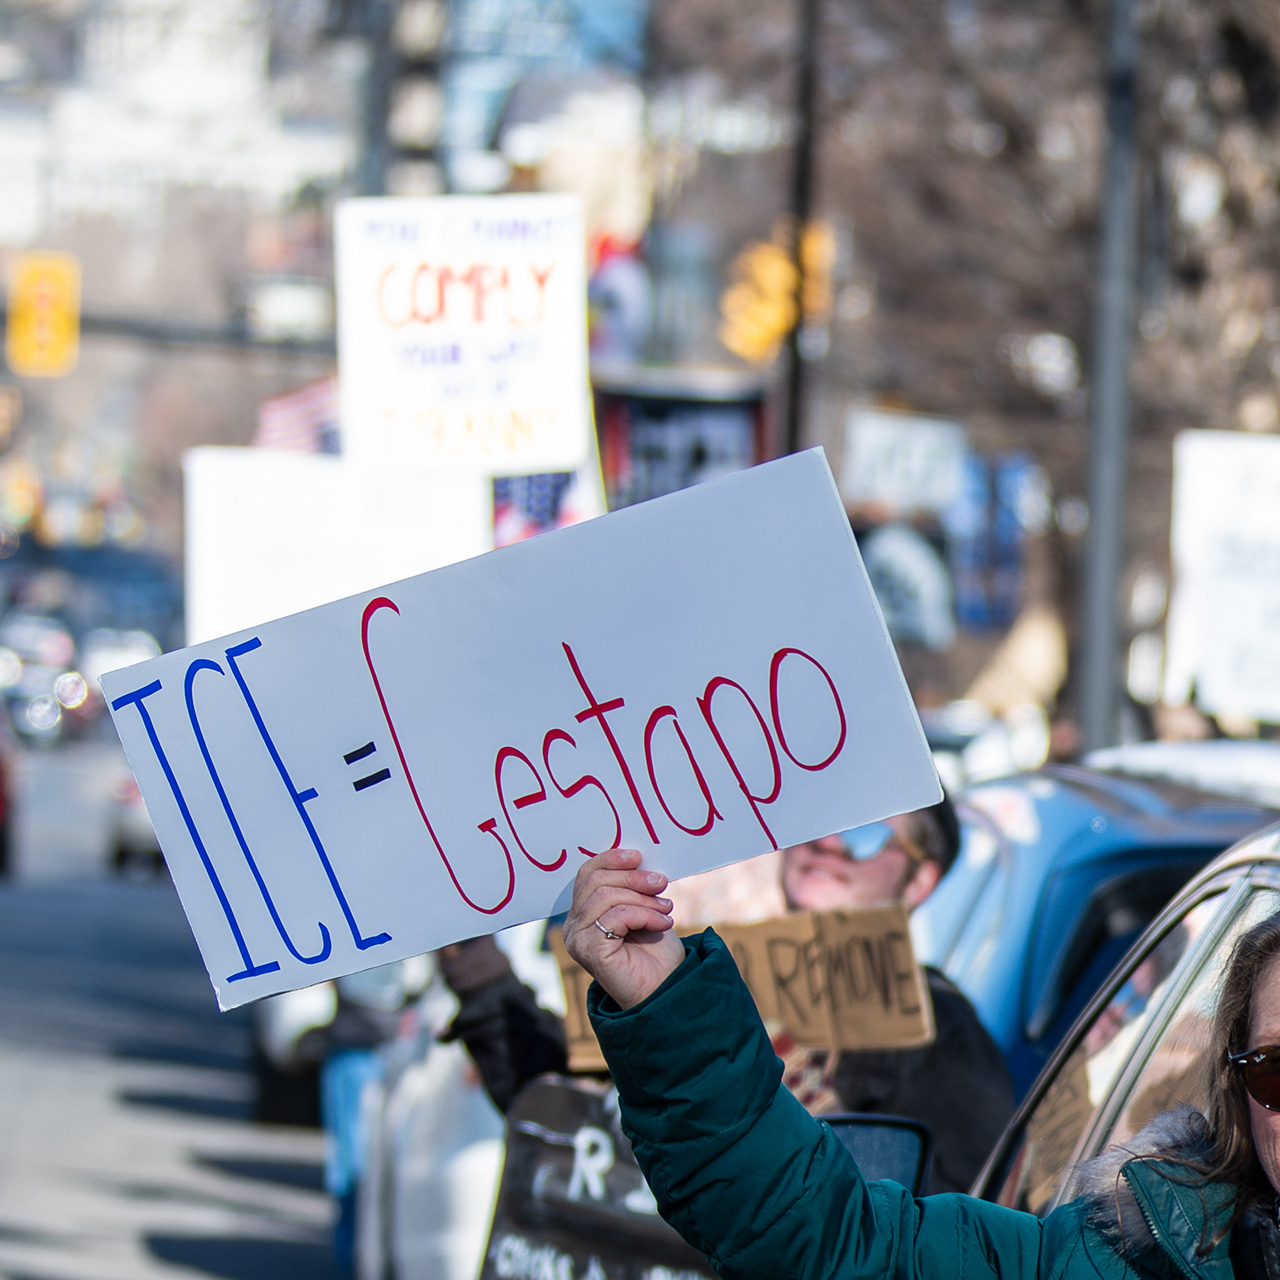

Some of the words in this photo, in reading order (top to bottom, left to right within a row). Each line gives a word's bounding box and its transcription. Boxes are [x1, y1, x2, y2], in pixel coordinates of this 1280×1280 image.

[375, 261, 556, 330] COMPLY
[112, 637, 392, 983] ICE
[344, 742, 391, 792] =
[361, 598, 847, 915] Gestapo
